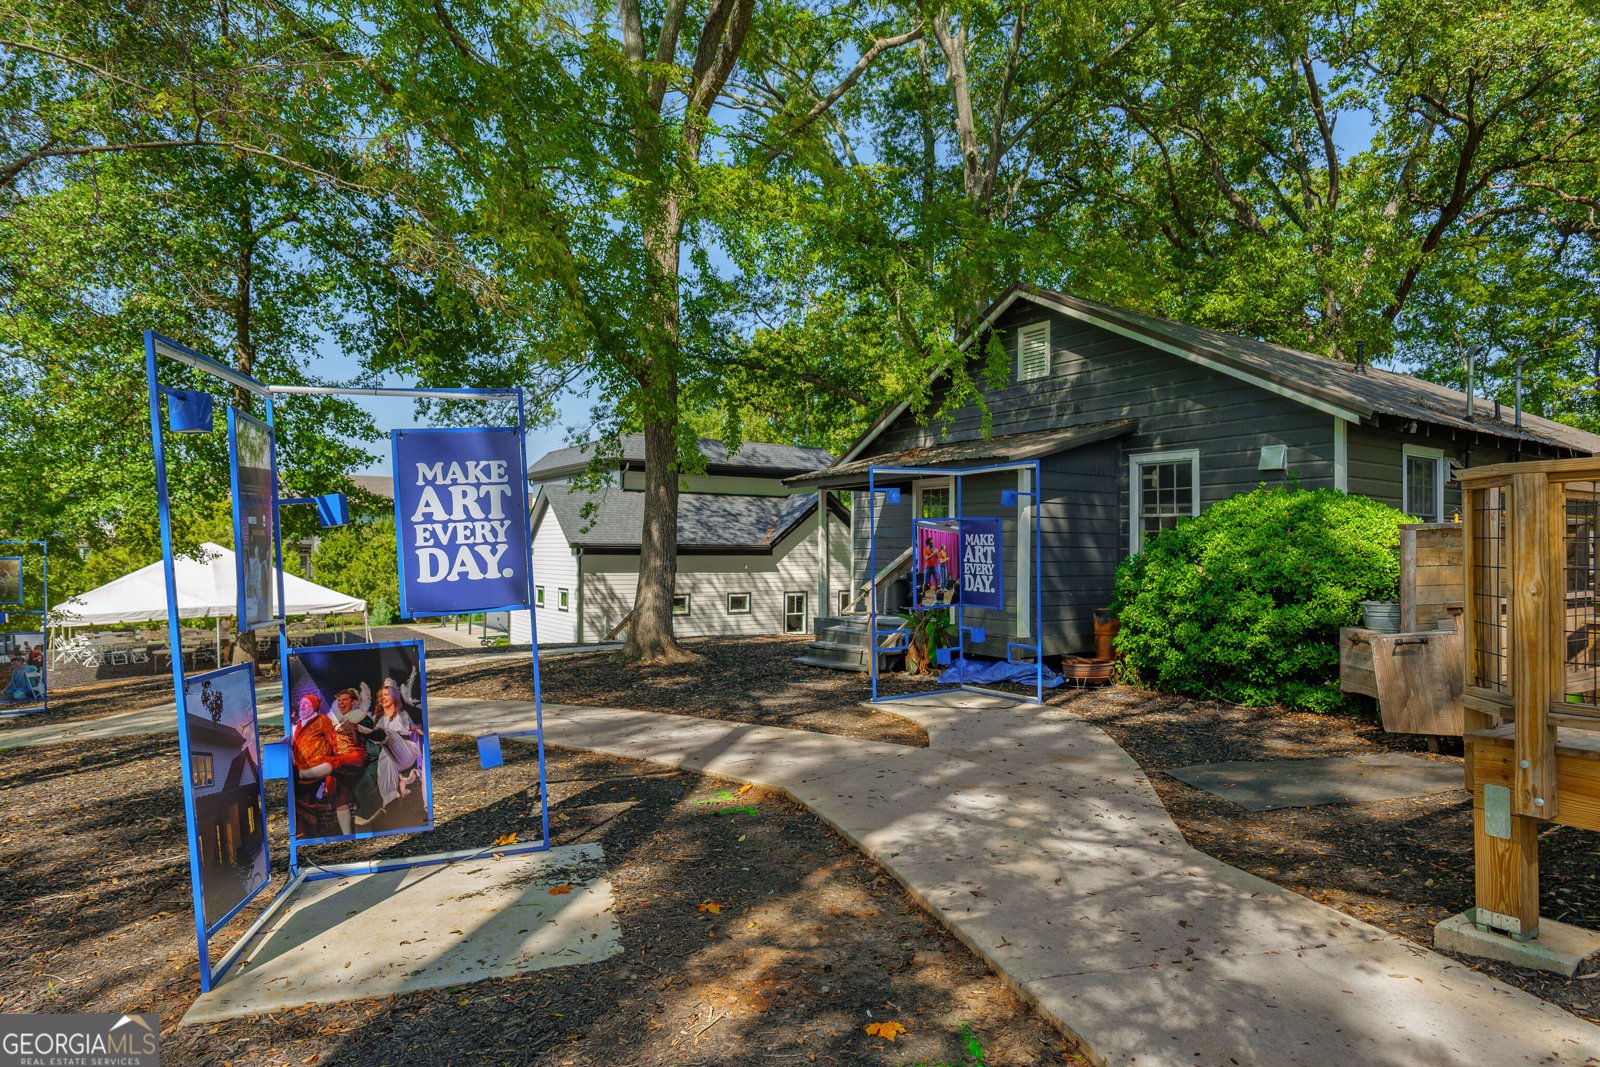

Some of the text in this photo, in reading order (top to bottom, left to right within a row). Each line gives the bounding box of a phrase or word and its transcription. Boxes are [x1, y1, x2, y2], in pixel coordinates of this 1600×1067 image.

[415, 460, 509, 485] MAKE
[410, 484, 512, 522] ART
[413, 520, 511, 546] EVERY
[965, 533, 995, 546] MAKE
[415, 543, 514, 583] DAY.
[963, 545, 996, 564] ART
[964, 562, 995, 575] EVERY
[964, 574, 996, 594] DAY.
